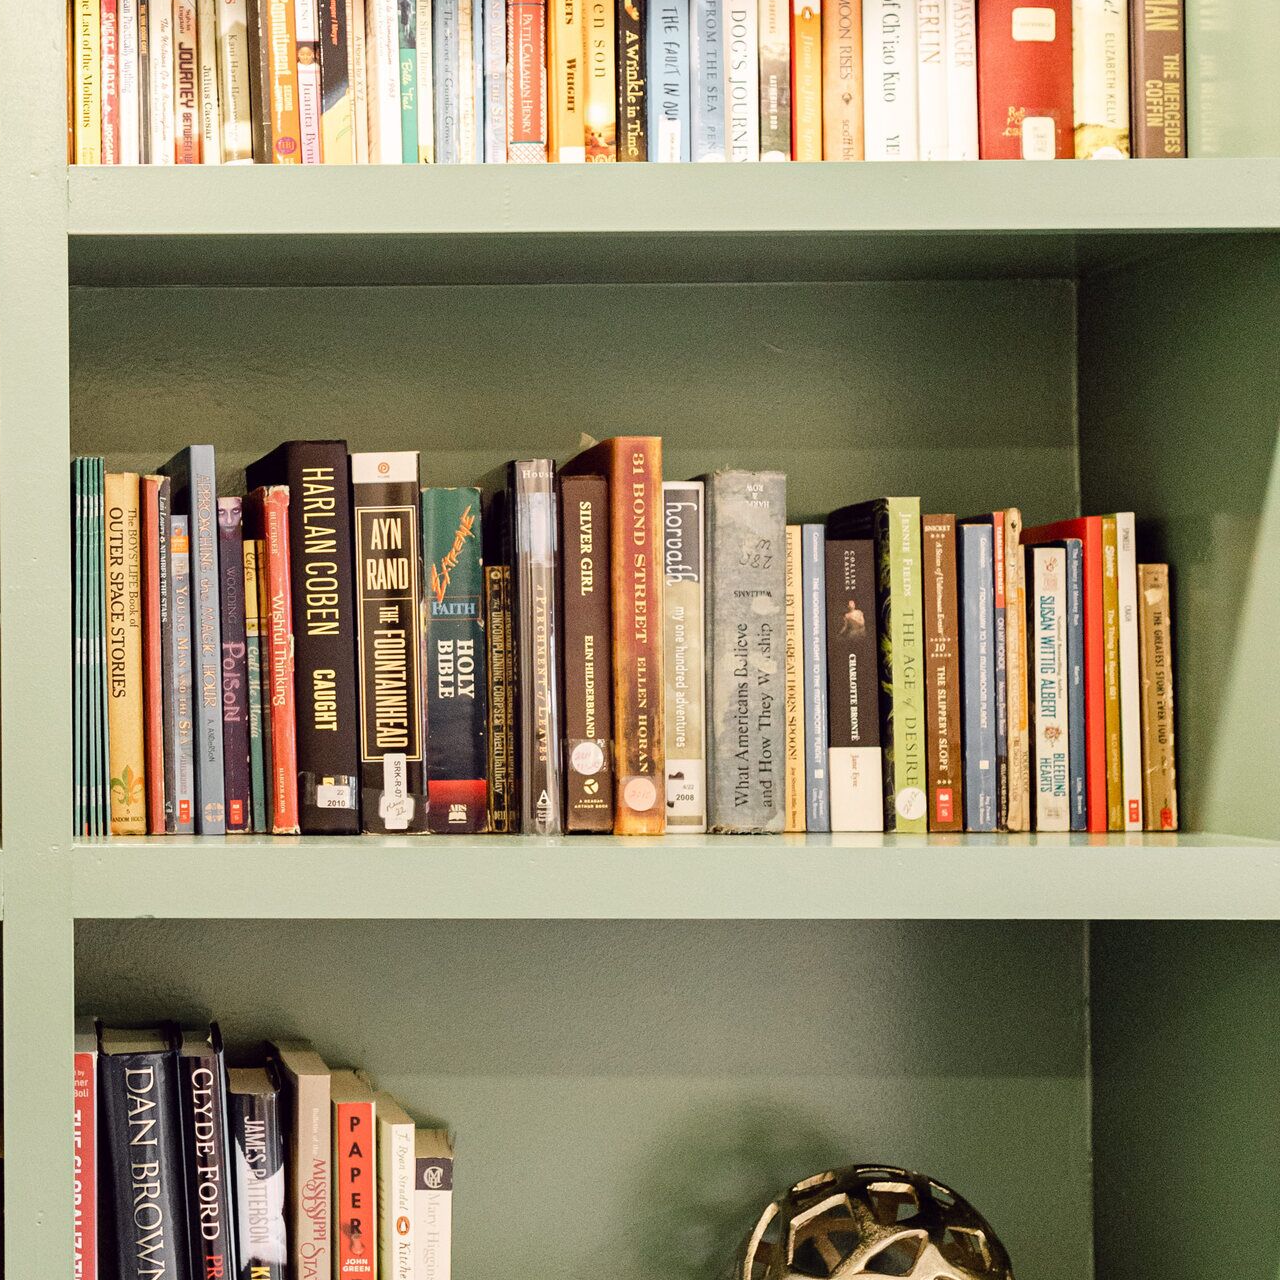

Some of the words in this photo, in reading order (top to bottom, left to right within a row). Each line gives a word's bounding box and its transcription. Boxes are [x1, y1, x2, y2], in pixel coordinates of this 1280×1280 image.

[839, 45, 854, 81] RISES
[1105, 32, 1116, 91] ELIZABETH
[1163, 53, 1179, 79] THE
[1106, 95, 1116, 124] KELLY
[1145, 79, 1163, 128] COFFIN
[1164, 81, 1181, 153] MERCEDES
[302, 467, 336, 554] HARLAN
[579, 501, 592, 556] SILVER
[109, 507, 124, 568] OUTER
[371, 518, 401, 550] AYN
[665, 500, 698, 587] horvath
[898, 512, 912, 554] JENNIE
[366, 558, 409, 590] RAND
[580, 559, 593, 596] GIRL
[899, 557, 913, 597] FIELDS
[110, 572, 125, 621] SPACE
[303, 561, 339, 636] COBEN
[379, 605, 399, 624] THE
[1040, 595, 1055, 629] SUSAN
[112, 626, 127, 699] STORIES
[438, 640, 455, 699] BIBLE
[457, 640, 475, 699] HOLY
[1040, 634, 1055, 673] WITTIG
[313, 669, 337, 731] CAUGHT
[373, 629, 408, 749] FOUNTAINHEAD
[1041, 678, 1056, 719] ALBERT
[393, 759, 402, 799] SRK-R-07
[1040, 757, 1053, 793] HEARTS
[1052, 752, 1065, 796] BLEEDING
[123, 1067, 157, 1146] DAN
[344, 1258, 369, 1266] JOHN
